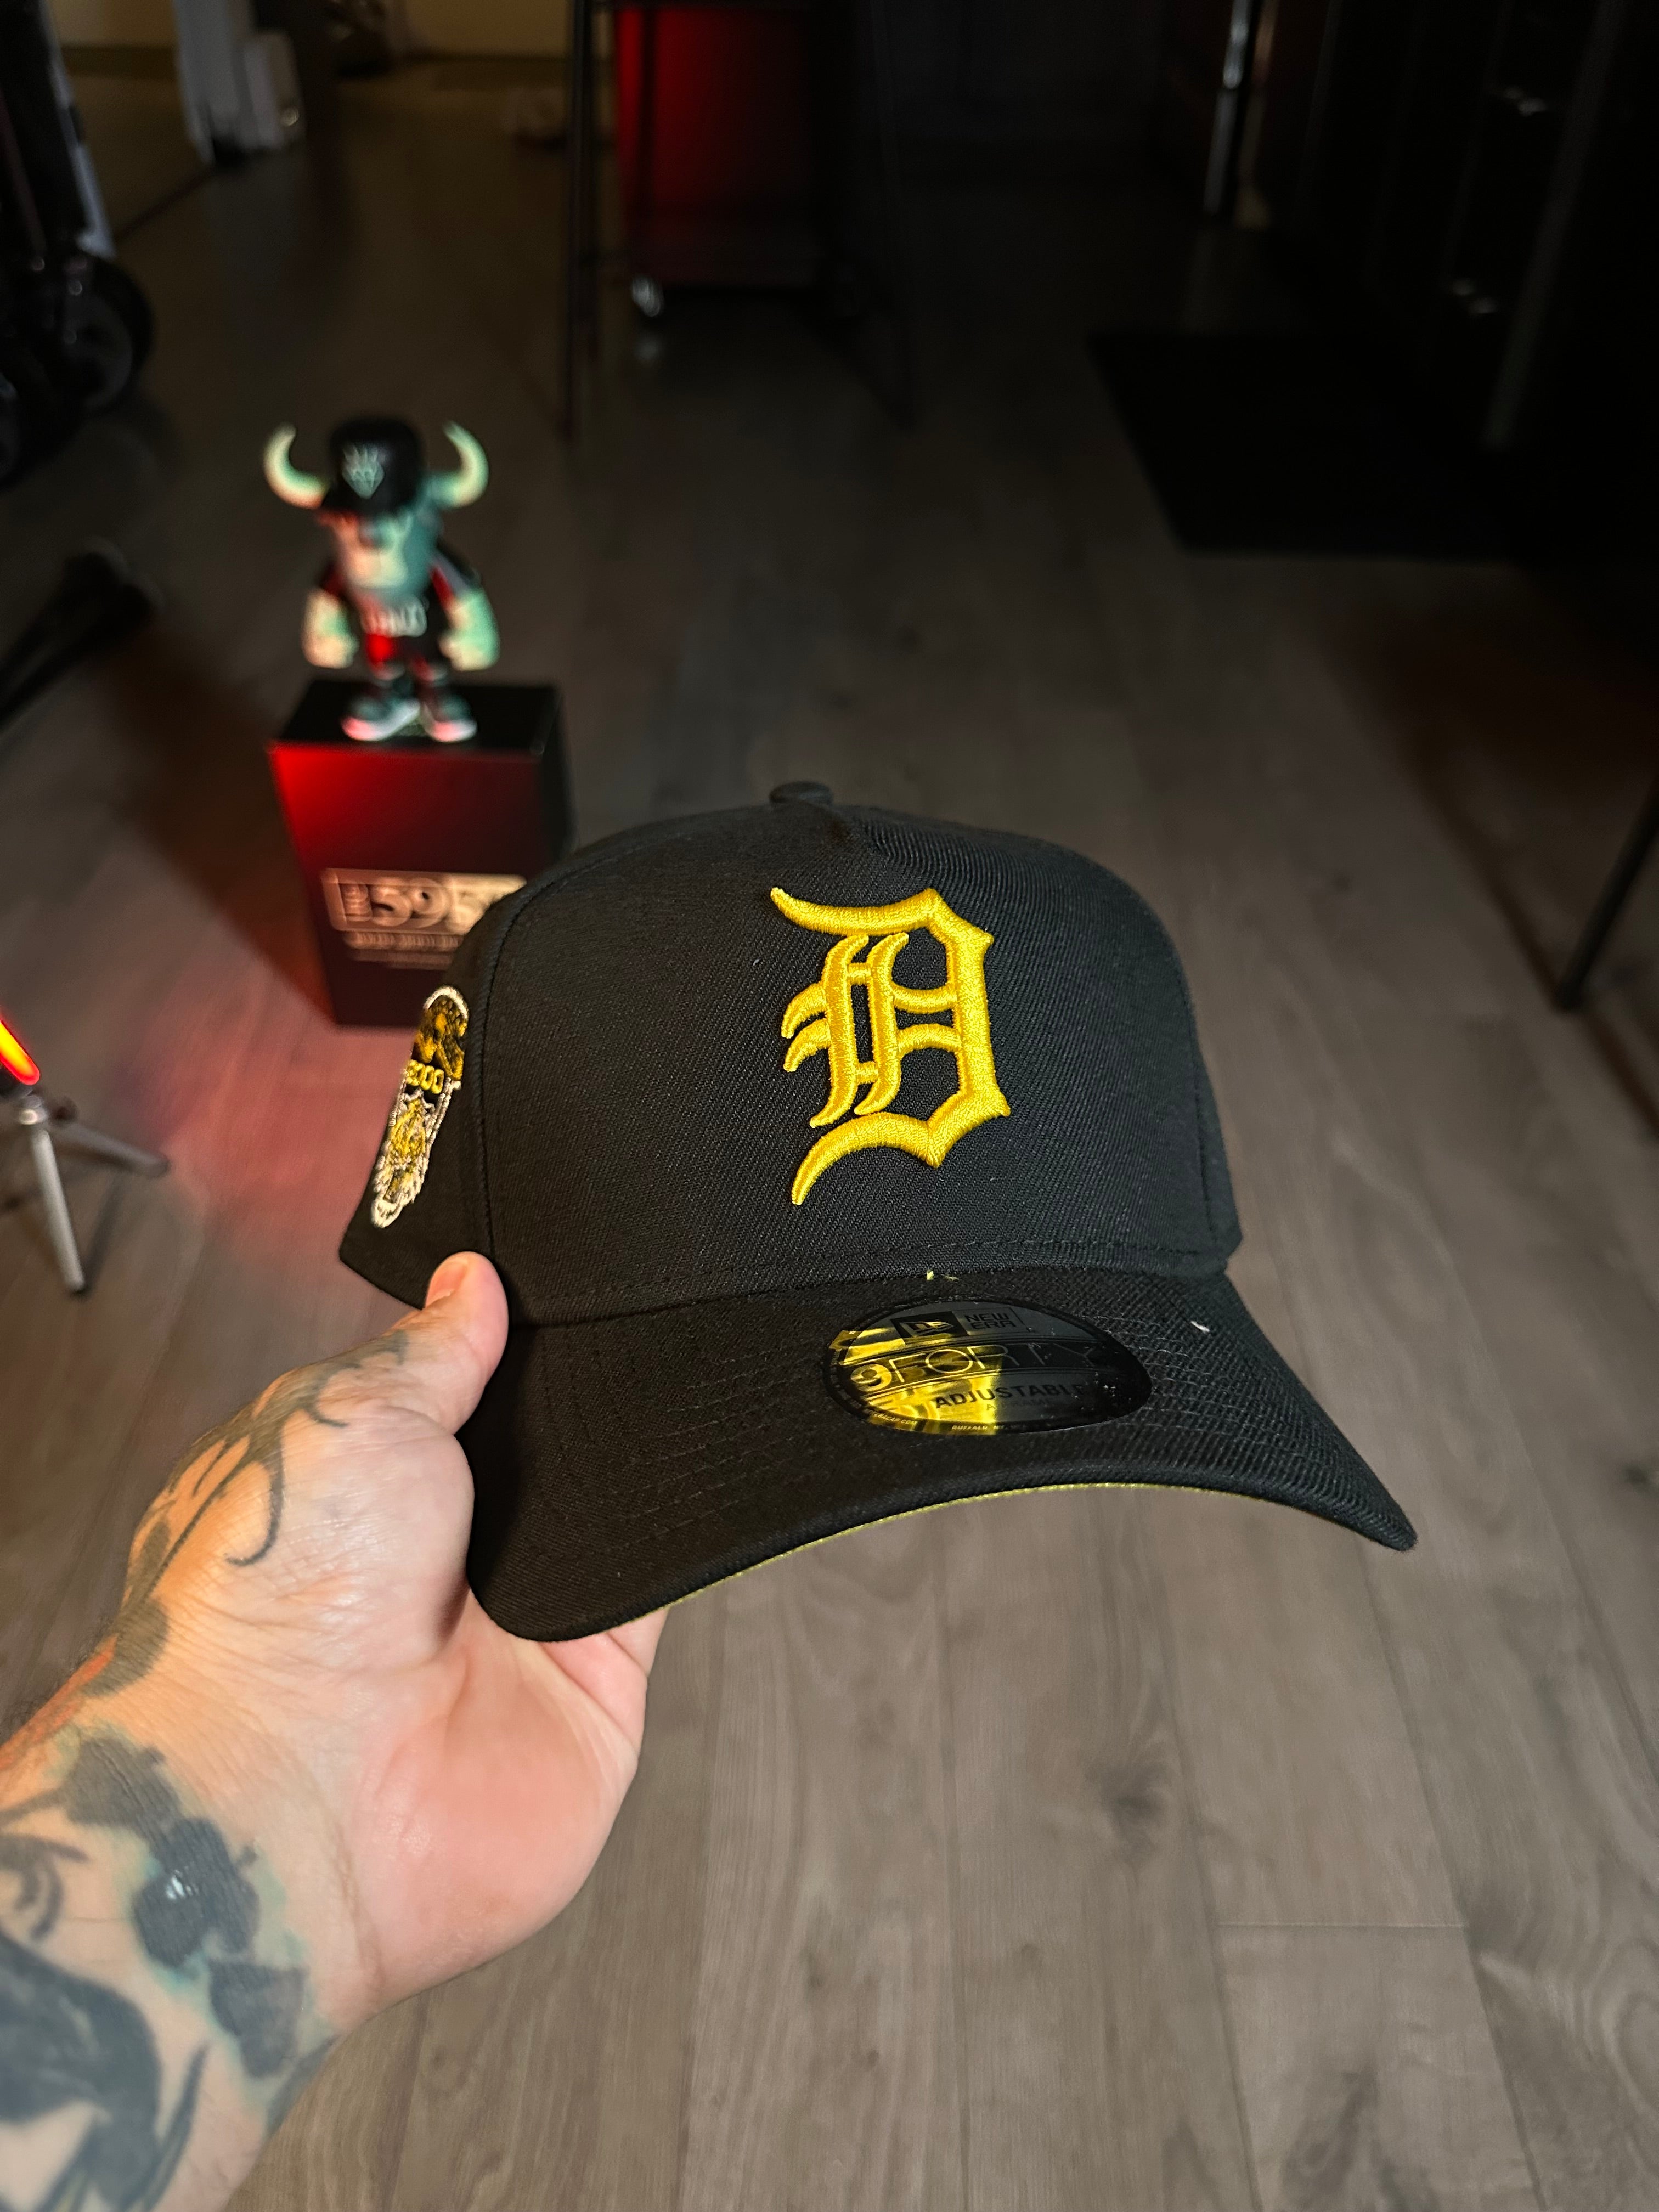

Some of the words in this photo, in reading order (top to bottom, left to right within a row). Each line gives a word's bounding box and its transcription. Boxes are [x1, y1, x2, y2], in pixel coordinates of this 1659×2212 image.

[770, 887, 1011, 1205] D
[964, 1312, 1009, 1323] NEW
[970, 1320, 1016, 1330] ERA
[850, 1342, 1096, 1392] 9FORTY
[935, 1383, 1085, 1409] ADJUSTABLE
